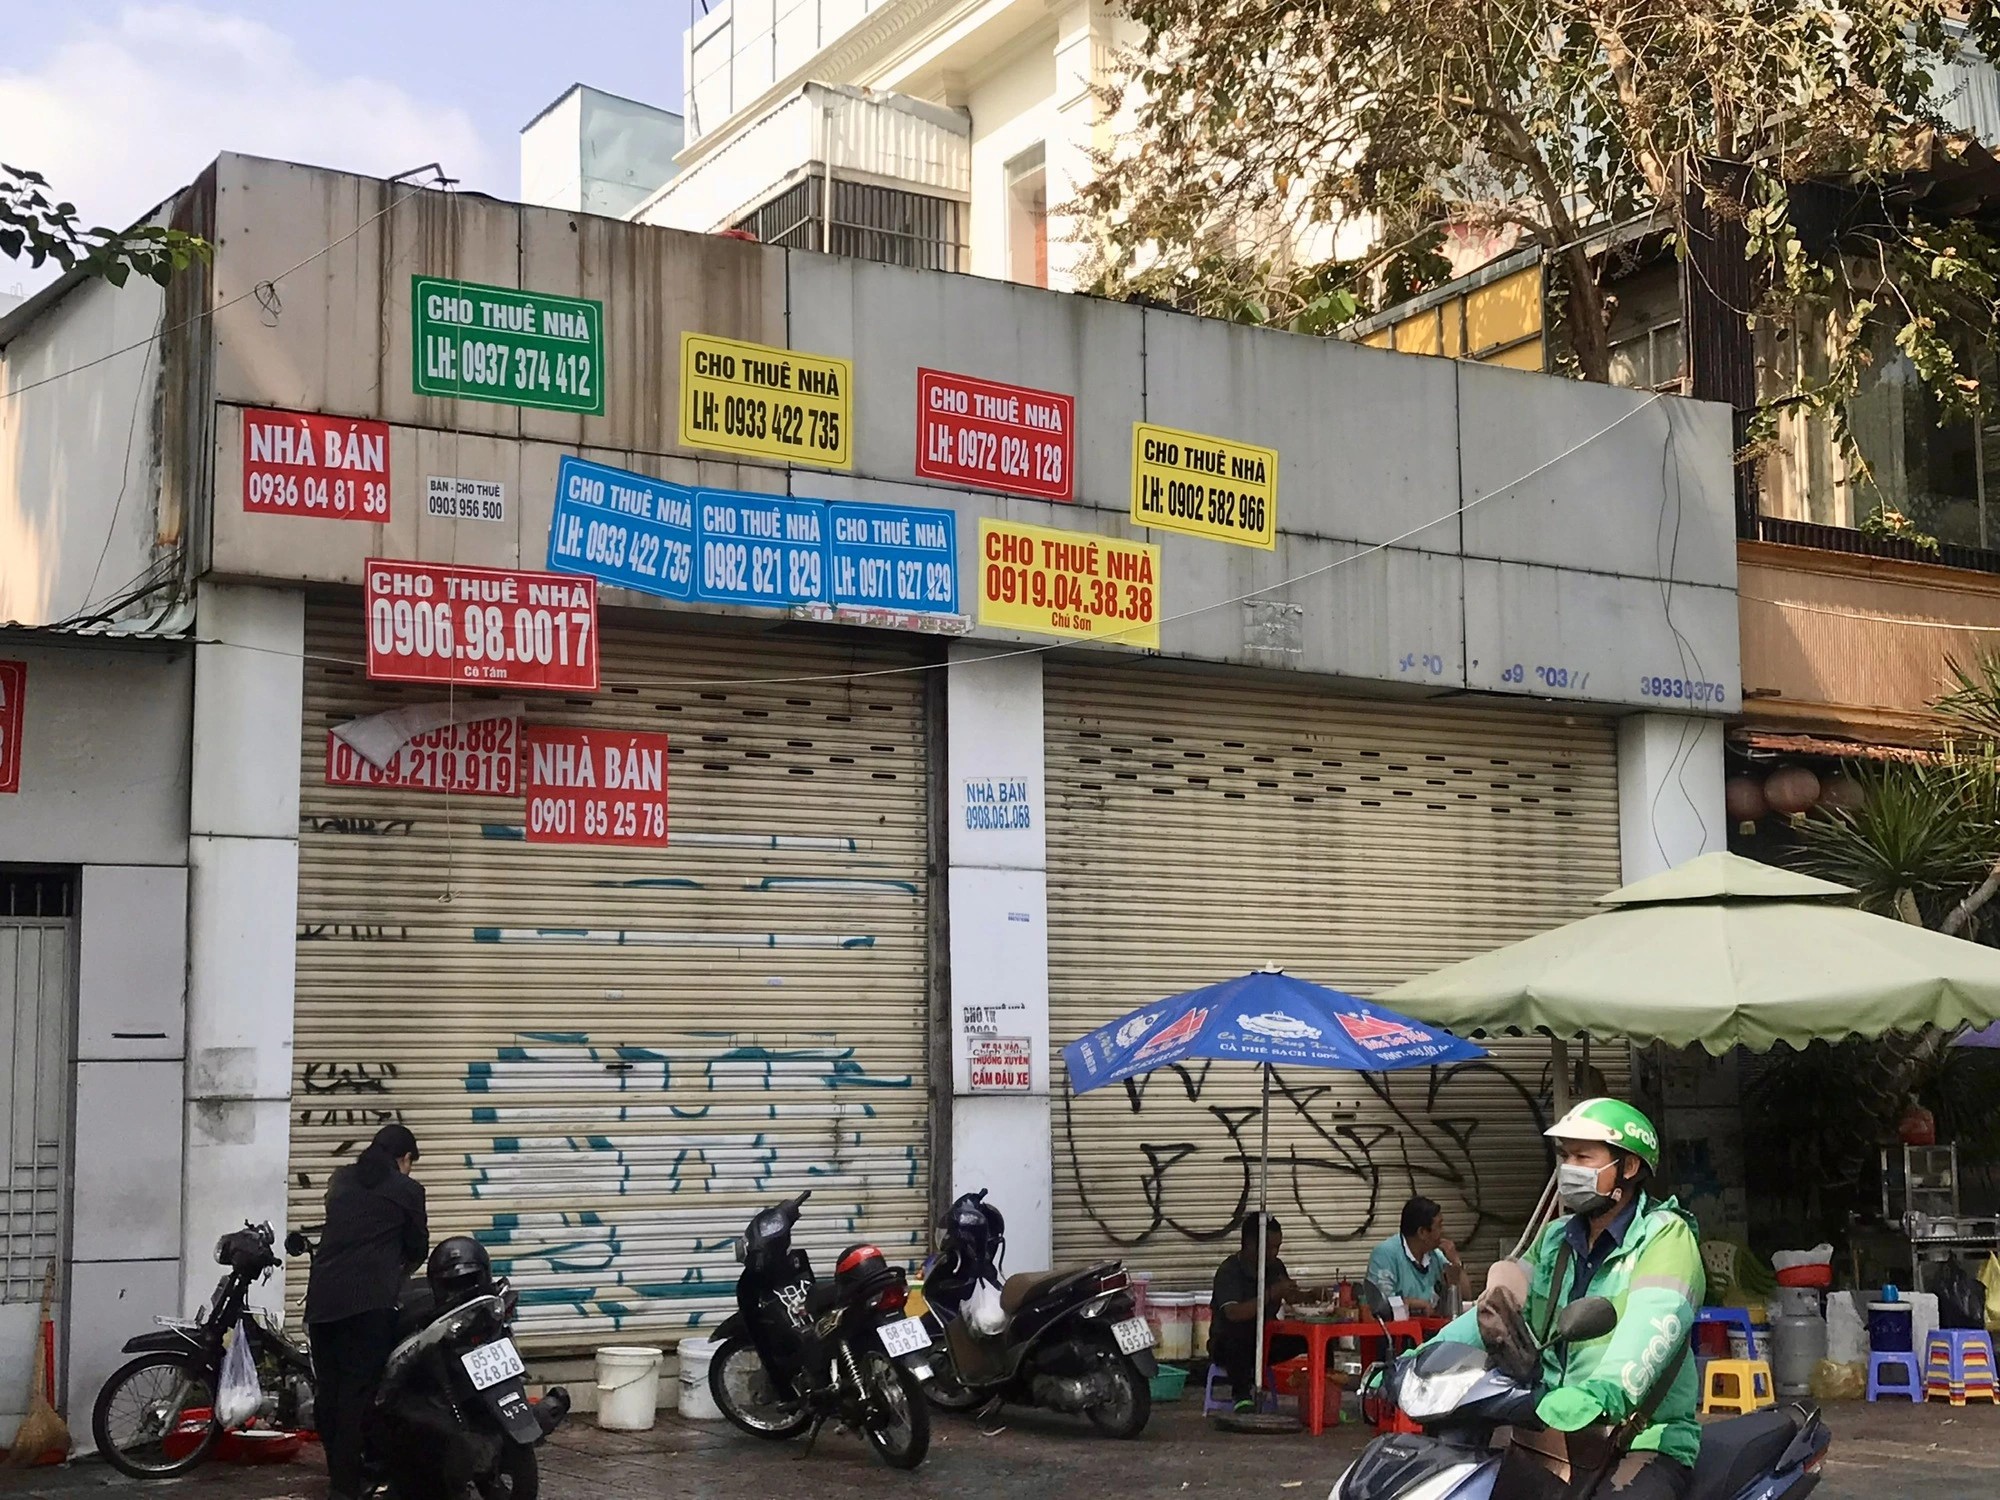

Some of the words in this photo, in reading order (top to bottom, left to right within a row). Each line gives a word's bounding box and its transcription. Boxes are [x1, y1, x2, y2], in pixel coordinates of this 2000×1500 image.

[427, 294, 474, 325] CHO
[480, 302, 536, 333] THUÊ
[543, 307, 590, 340] NHÀ
[426, 335, 457, 380] LH:
[462, 340, 510, 387] 0937
[515, 347, 551, 393] 374
[555, 353, 592, 397] 412
[694, 351, 736, 381] CHO
[741, 355, 792, 389] THUÊ
[798, 367, 840, 397] NHÀ
[692, 389, 720, 433] LH:
[724, 396, 768, 441] 0933
[771, 402, 804, 446] 422
[808, 408, 839, 452] 735
[929, 385, 969, 413] CHO
[973, 391, 1020, 423] THUÊ
[1024, 403, 1062, 432] NHÀ
[249, 418, 316, 467] NHÀ
[324, 424, 385, 473] BÁN
[928, 422, 953, 465] LH:
[957, 428, 997, 473] 0972
[1000, 434, 1030, 478] 024
[1034, 440, 1062, 484] 128
[1144, 438, 1180, 467] CHO
[1184, 448, 1226, 476] THUÊ
[1231, 457, 1266, 484] NHÀ
[249, 471, 299, 508] 0936
[303, 478, 329, 509] 04
[333, 480, 355, 512] 81
[363, 482, 387, 514] 38
[429, 495, 457, 515] 0903
[459, 498, 480, 517] 956
[482, 501, 502, 520] 500
[456, 482, 475, 494] CHO
[476, 484, 501, 497] THUÊ
[567, 475, 605, 506] CHO
[609, 483, 654, 516] THUÊ
[656, 496, 692, 529] NHÀ
[1142, 474, 1164, 514] LH:
[1168, 480, 1204, 522] 0902
[1207, 487, 1235, 526] 582
[1238, 492, 1266, 533] 966
[703, 504, 737, 534] CHO
[740, 506, 781, 540] THUÊ
[786, 511, 821, 543] NHÀ
[836, 516, 868, 544] CHO
[873, 518, 911, 547] THUÊ
[915, 520, 947, 550] NHÀ
[556, 512, 583, 557] LH:
[585, 519, 628, 568] 0933
[628, 531, 662, 578] 422
[663, 539, 692, 585] 735
[703, 541, 749, 592] 0982
[752, 545, 782, 596] 821
[789, 549, 821, 599] 829
[985, 531, 1034, 566] CHO
[1041, 540, 1099, 577] THUÊ
[1107, 550, 1153, 586] NHÀ
[371, 571, 434, 598] CHO
[443, 575, 519, 604] THUÊ
[528, 582, 590, 609] NHÀ
[834, 555, 856, 596] LH:
[859, 557, 892, 600] 0971
[896, 560, 923, 601] 627
[926, 562, 952, 603] 929
[986, 564, 1154, 624] 0919.04.38.38
[371, 598, 592, 667] 0906.98.0017
[1051, 611, 1070, 629] Chú
[1072, 612, 1092, 632] Sơn
[464, 665, 479, 678] Cô
[482, 664, 508, 679] Tám
[531, 735, 597, 788] NHÀ
[604, 738, 663, 791] BÁN
[966, 778, 995, 802] NHÀ
[998, 778, 1026, 802] BÁN
[531, 797, 576, 835] 0901
[584, 799, 607, 836] 85
[612, 801, 638, 838] 25
[642, 802, 665, 838] 78
[1220, 1043, 1238, 1052] CÀ
[1241, 1045, 1268, 1054] PHÊ
[972, 1067, 993, 1085] CẤM
[1016, 1072, 1029, 1085] XE
[1625, 1121, 1658, 1150] Grab
[1621, 1312, 1682, 1398] Grab
